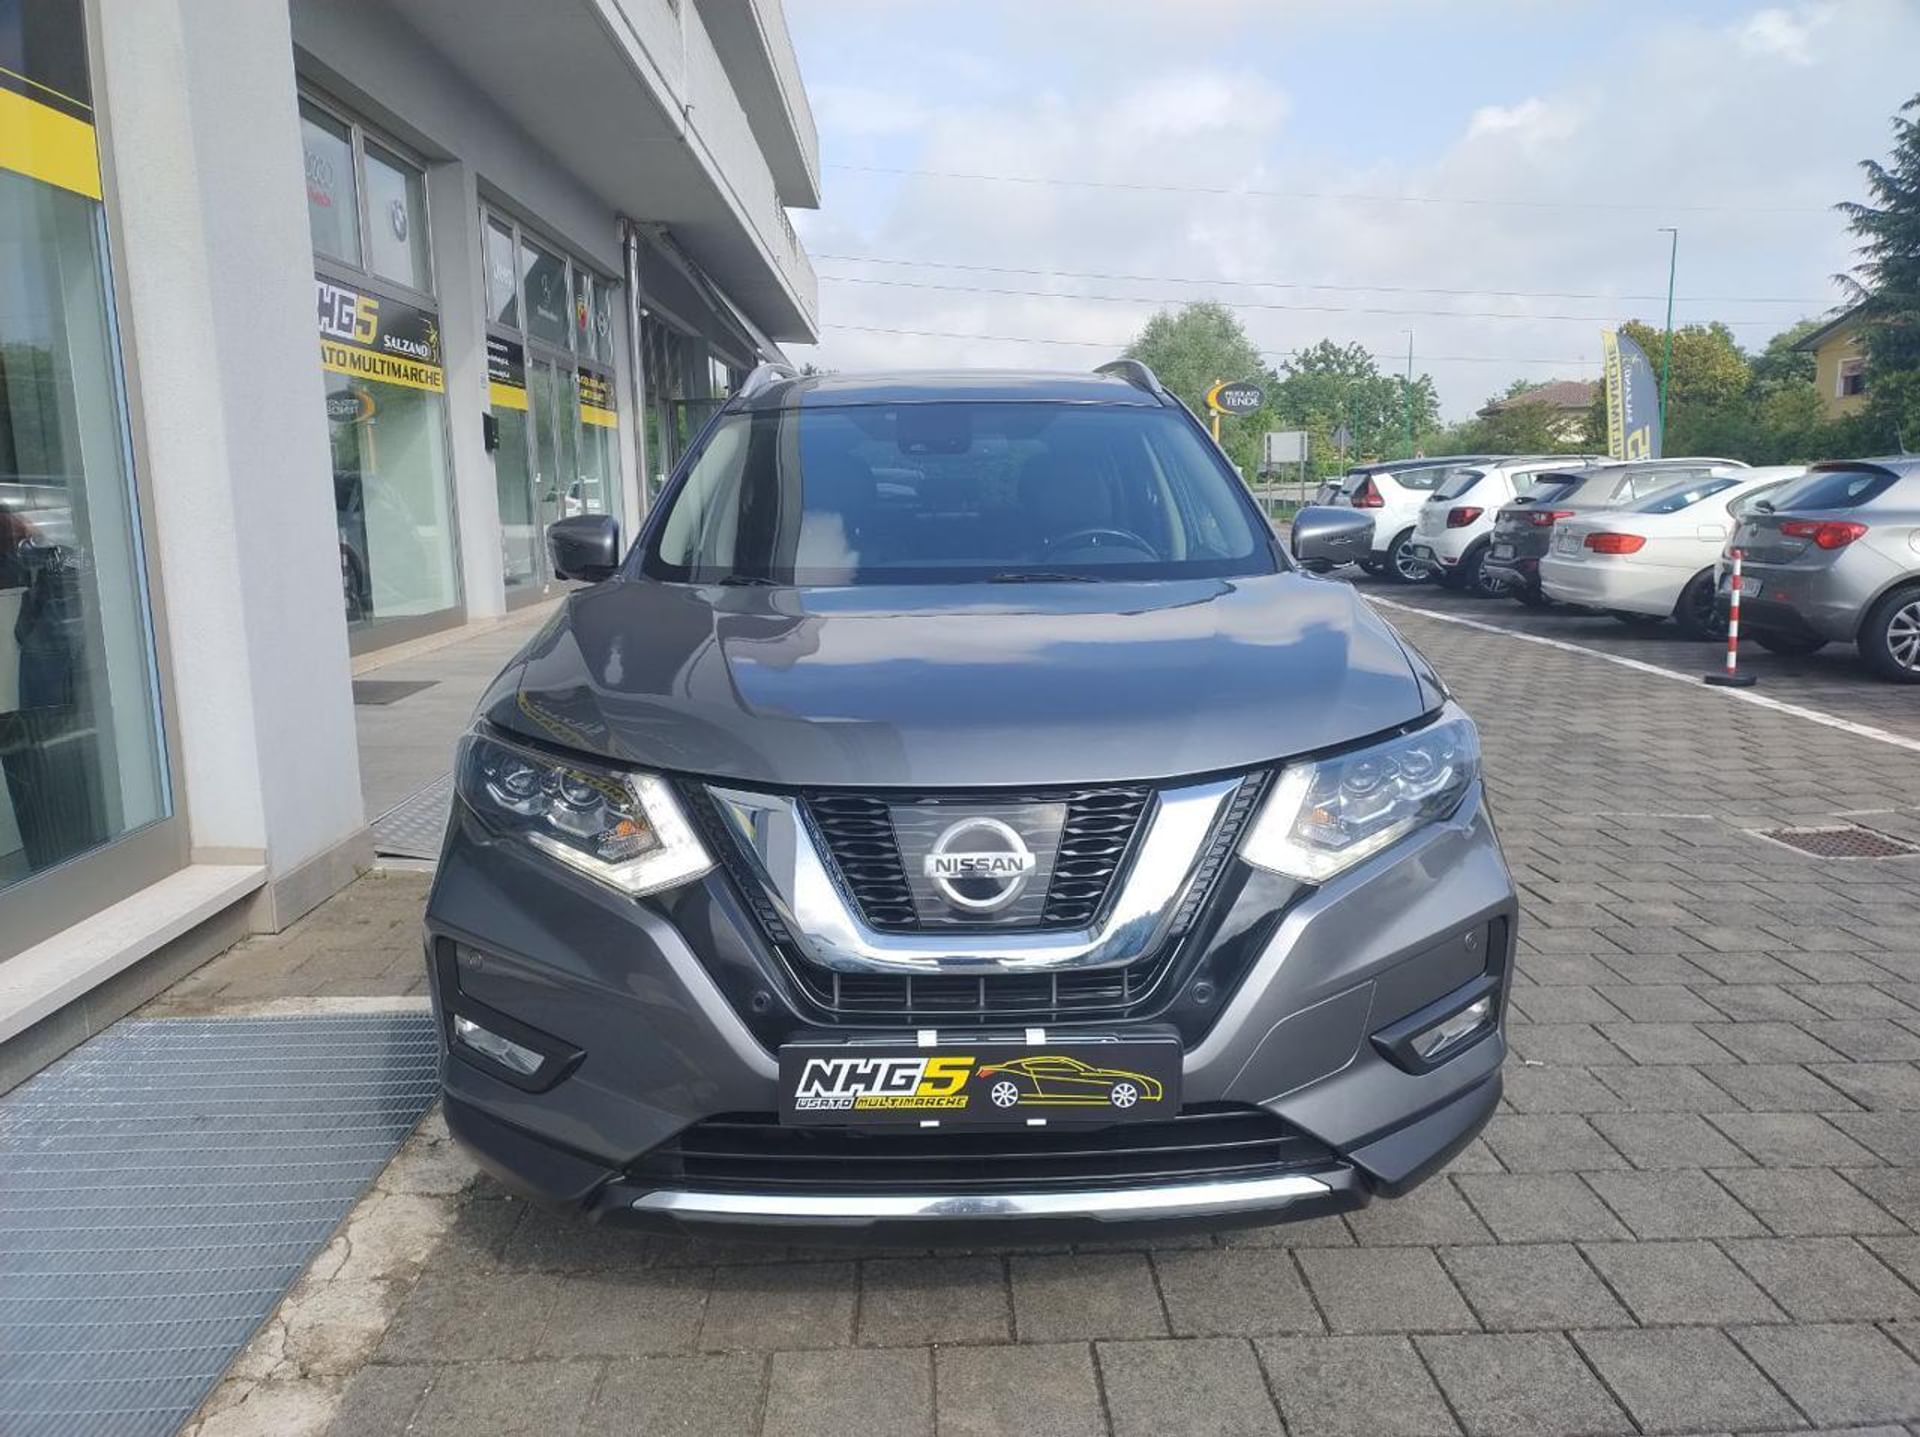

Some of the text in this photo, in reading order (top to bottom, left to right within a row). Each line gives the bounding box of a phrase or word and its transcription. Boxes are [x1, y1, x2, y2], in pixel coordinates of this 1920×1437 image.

[382, 334, 429, 358] SALZANO
[349, 350, 441, 387] MULTIMARCHE
[1226, 397, 1260, 407] TENDE
[935, 857, 1024, 873] NISSAN
[794, 1056, 976, 1098] NHG5
[795, 1096, 969, 1110] USATO MULTIMARCHE
